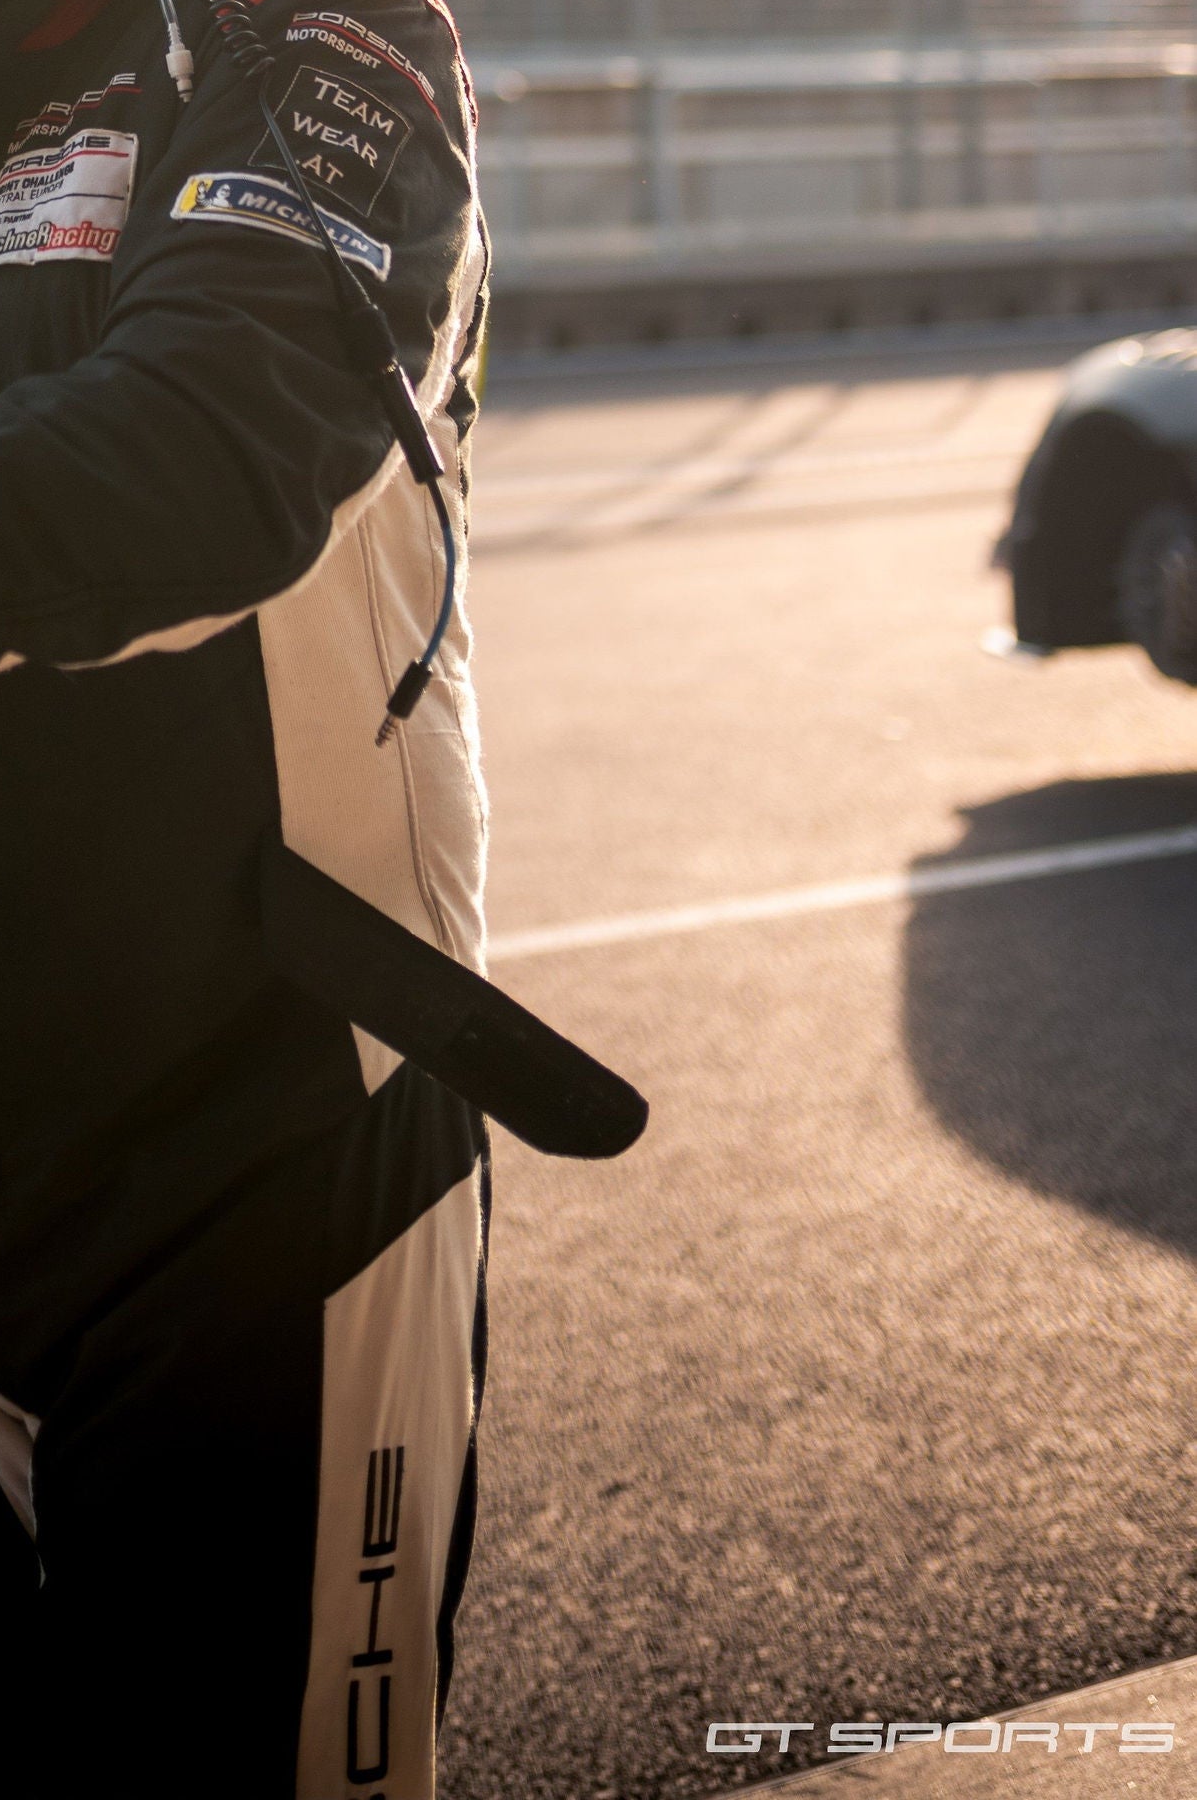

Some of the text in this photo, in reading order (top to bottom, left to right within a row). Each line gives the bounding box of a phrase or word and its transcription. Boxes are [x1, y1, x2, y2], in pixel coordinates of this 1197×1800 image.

[286, 28, 382, 70] MOTORSPORT
[291, 11, 437, 100] PORSCHE
[313, 76, 395, 136] TEAM
[292, 110, 379, 168] WEAR
[238, 191, 370, 253] MICHLIN
[346, 1445, 405, 1800] CHE
